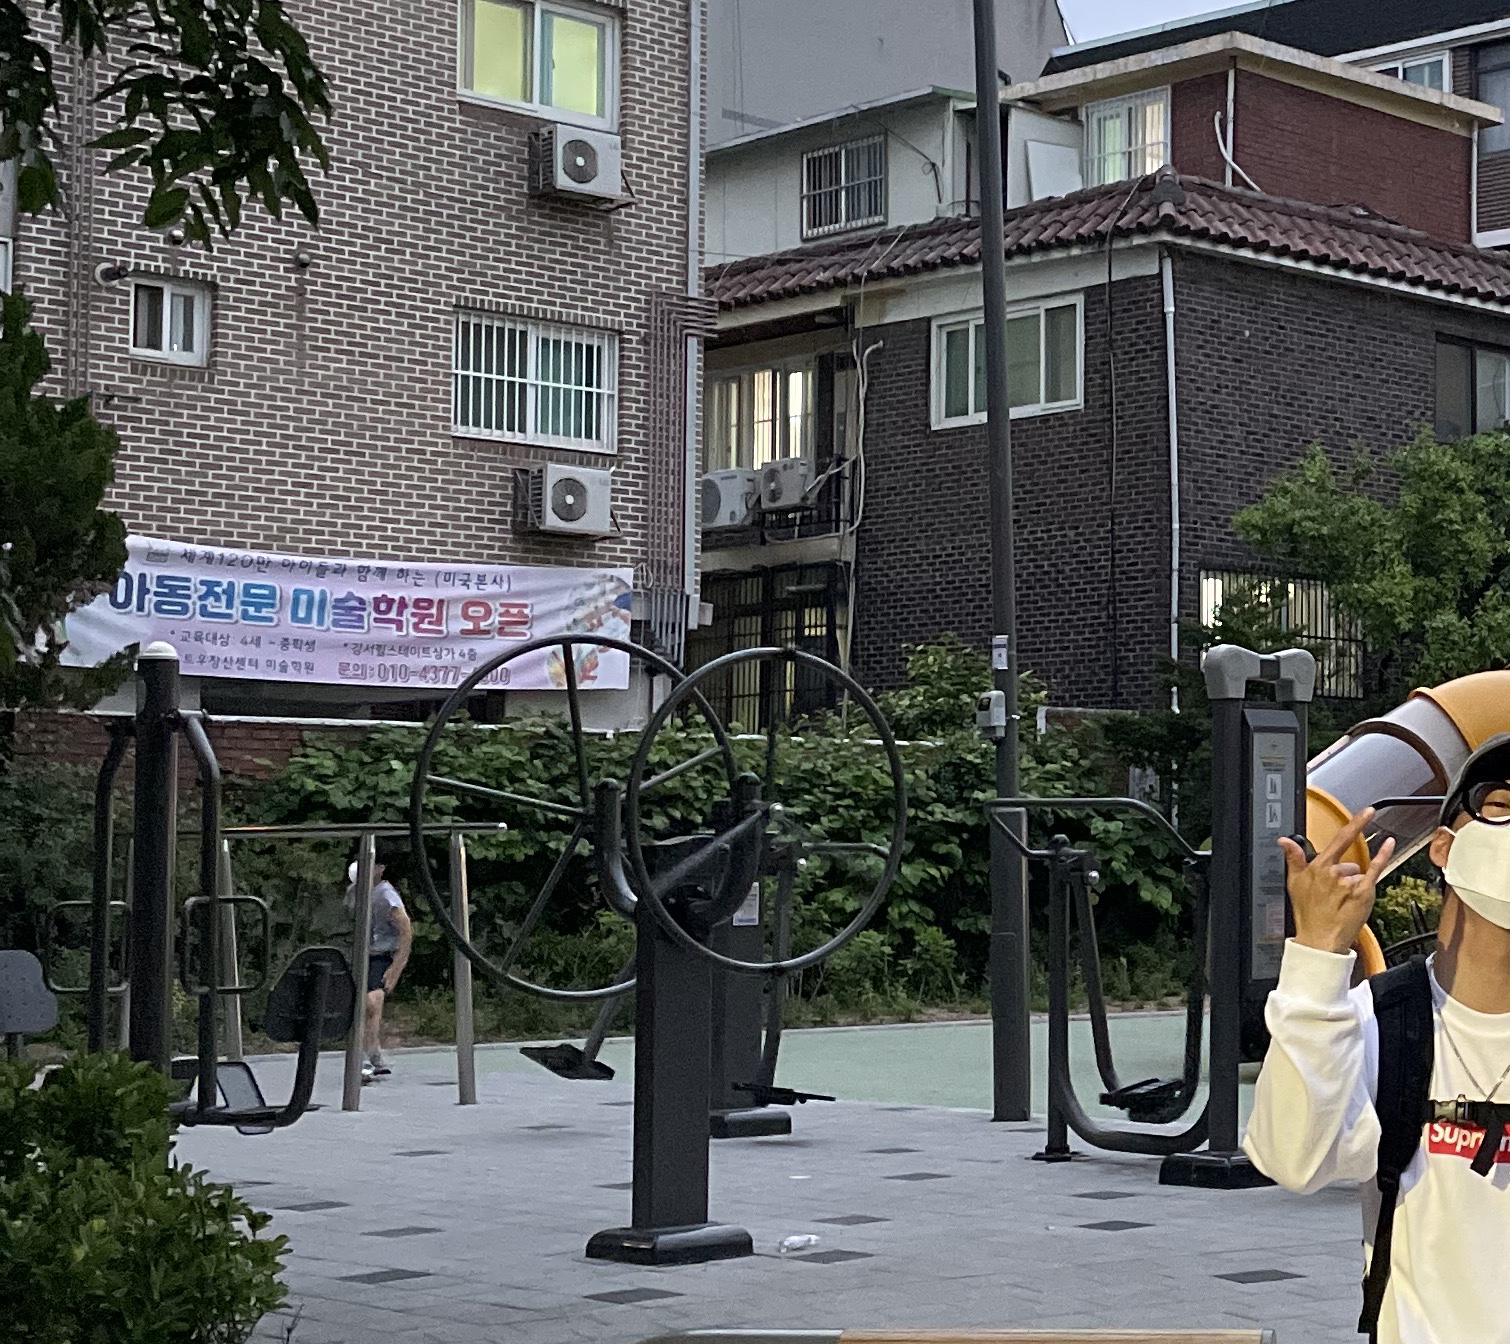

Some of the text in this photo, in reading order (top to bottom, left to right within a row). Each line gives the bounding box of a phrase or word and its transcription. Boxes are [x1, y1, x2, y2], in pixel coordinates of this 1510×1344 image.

[434, 571, 512, 593] (미국본사)
[108, 571, 530, 638] 아동전문 미술학원 오픈
